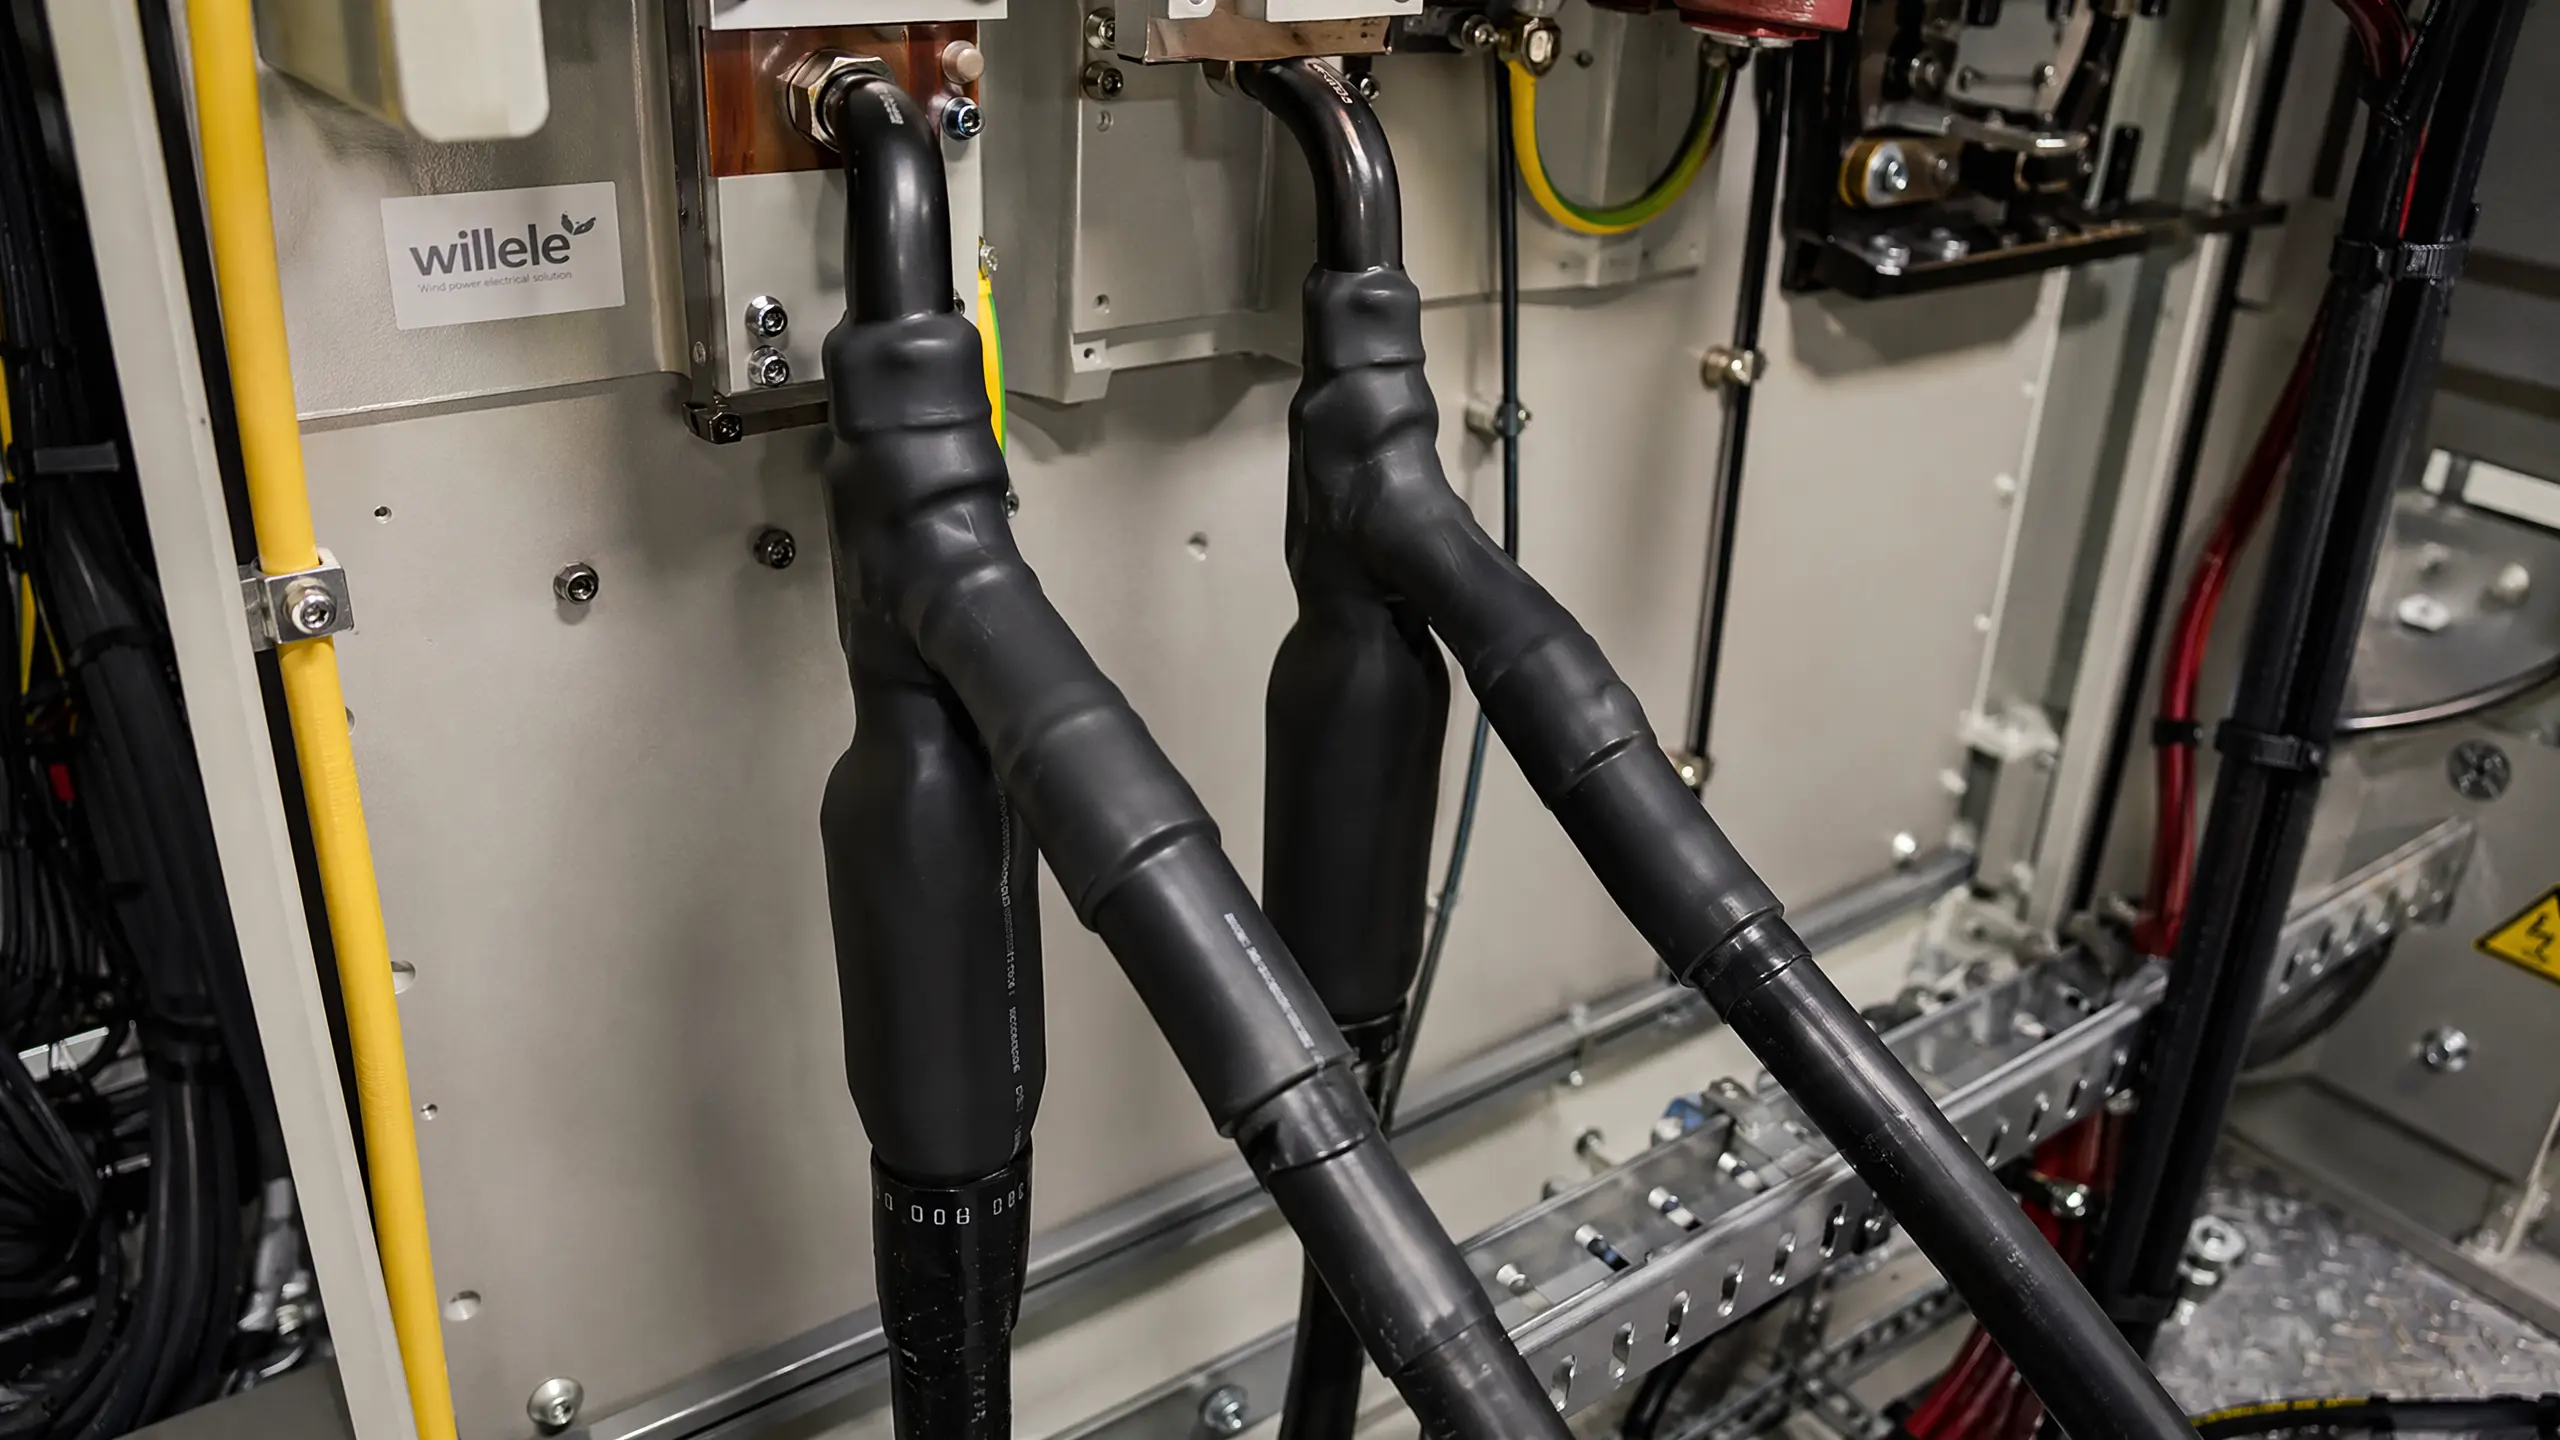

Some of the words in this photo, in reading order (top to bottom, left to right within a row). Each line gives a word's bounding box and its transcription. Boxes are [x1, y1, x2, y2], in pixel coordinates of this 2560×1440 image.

[409, 224, 570, 276] willele
[418, 281, 447, 294] Wind
[449, 280, 481, 293] power
[484, 273, 530, 287] electrical
[532, 271, 573, 282] solution
